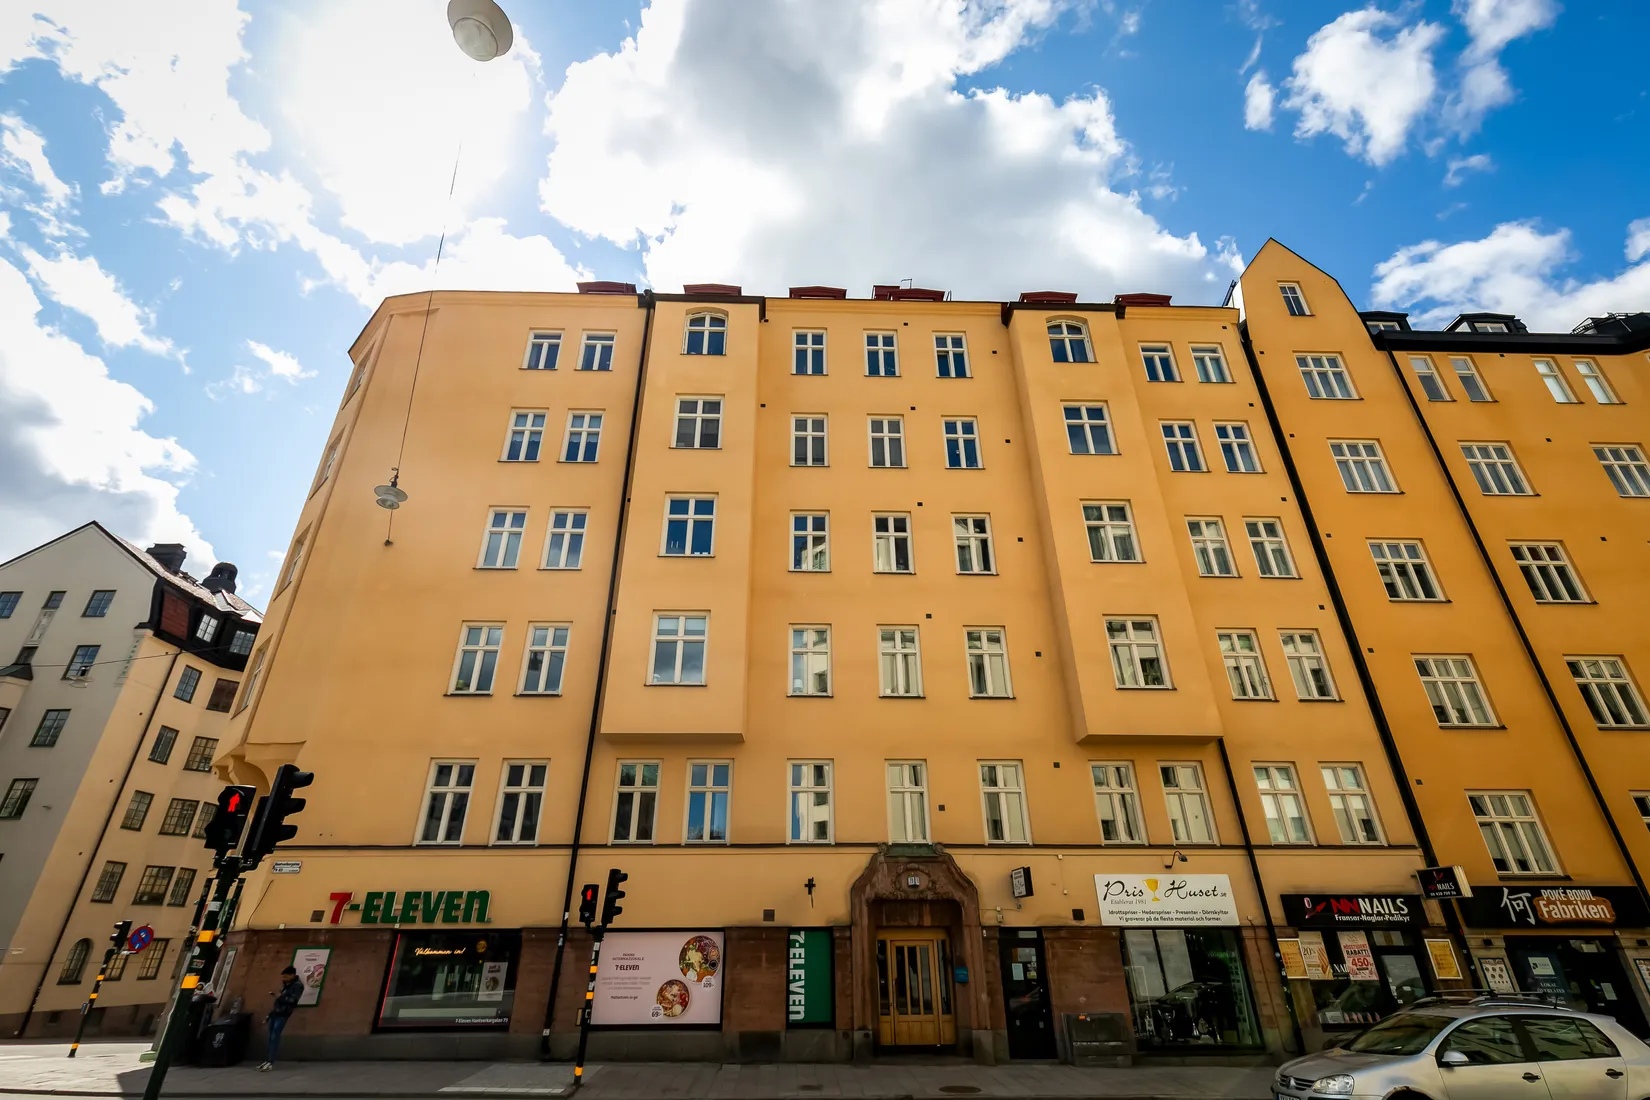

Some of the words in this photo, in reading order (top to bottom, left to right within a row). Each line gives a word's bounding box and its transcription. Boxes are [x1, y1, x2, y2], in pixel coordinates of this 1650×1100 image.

[1103, 880, 1144, 901] Pris
[1164, 880, 1218, 899] Huset
[1540, 887, 1566, 901] POKÉ
[1566, 889, 1596, 901] BOWL
[330, 890, 490, 924] 7-ELEVEN
[1500, 887, 1536, 925] 何
[1539, 900, 1611, 919] Fabriken
[1351, 957, 1369, 967] 450
[789, 931, 805, 1021] 7-ELEVEN
